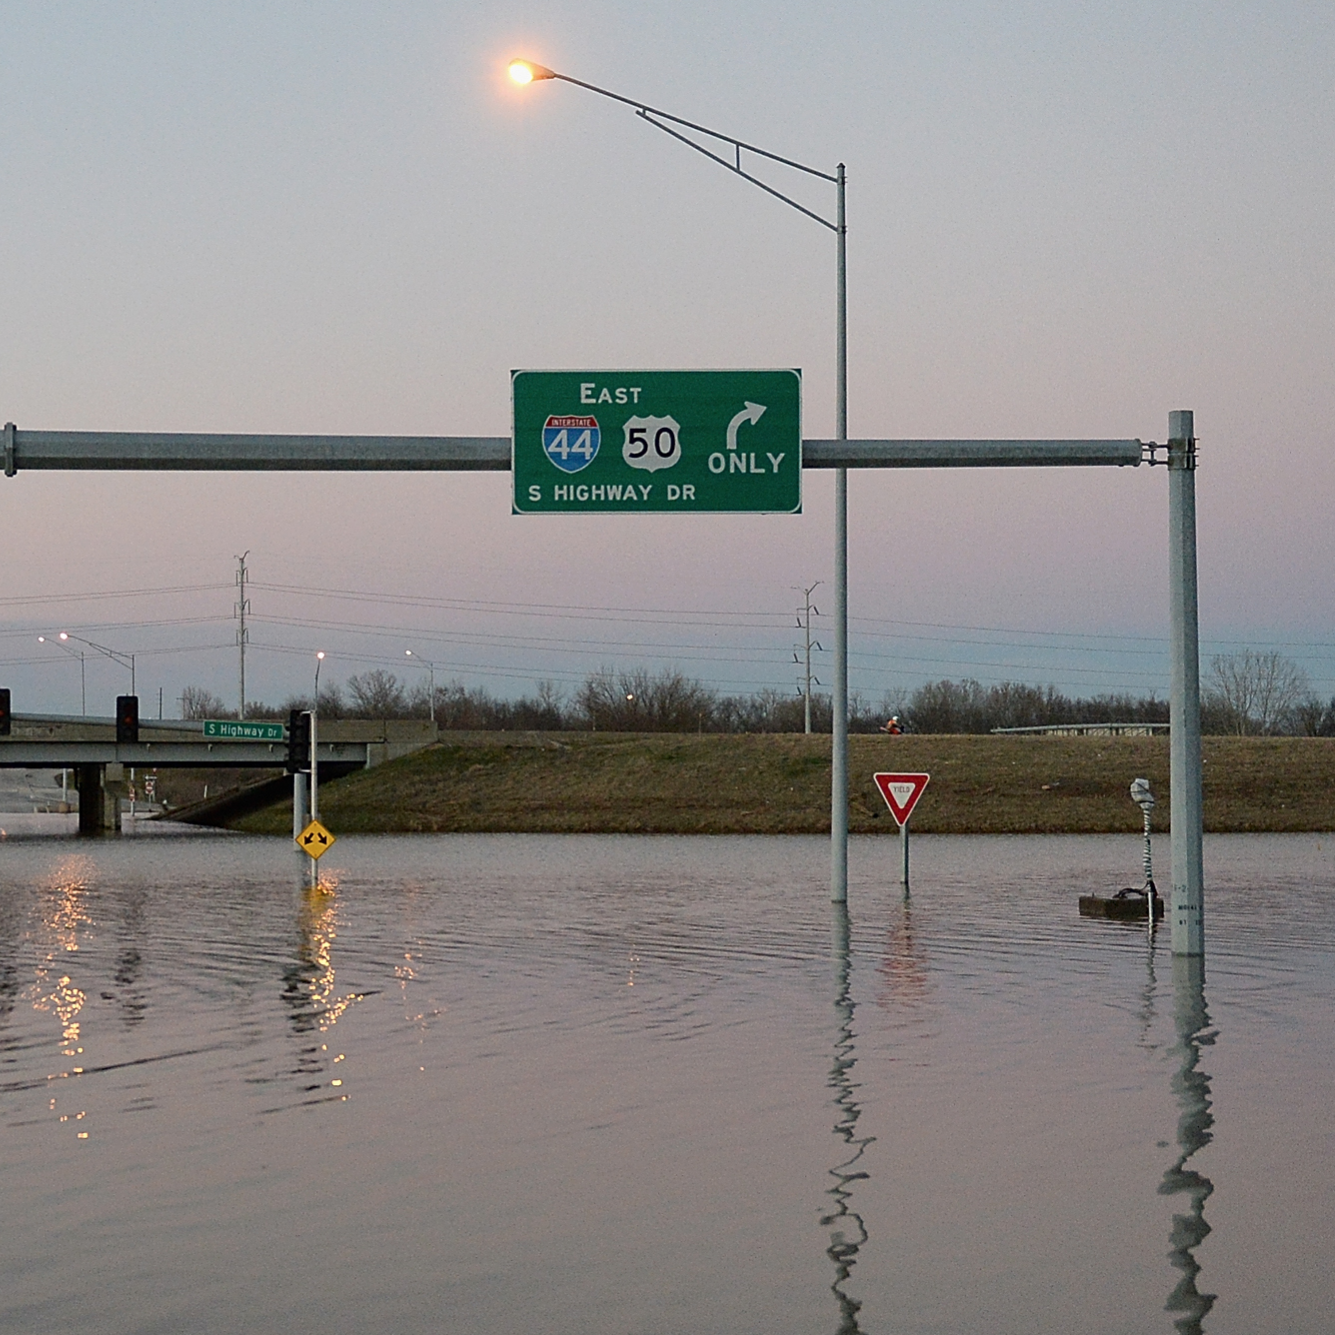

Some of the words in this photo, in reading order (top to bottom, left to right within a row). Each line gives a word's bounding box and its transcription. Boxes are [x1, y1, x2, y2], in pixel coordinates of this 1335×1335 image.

[551, 418, 592, 427] INTERSTATE
[547, 429, 594, 460] 44
[628, 427, 676, 459] 50
[707, 452, 786, 474] ONLY
[528, 485, 542, 501] S
[554, 485, 653, 501] HIGHWAY
[667, 485, 696, 501] DR
[208, 723, 216, 735] S
[220, 724, 264, 738] Highway
[267, 728, 277, 737] Dr
